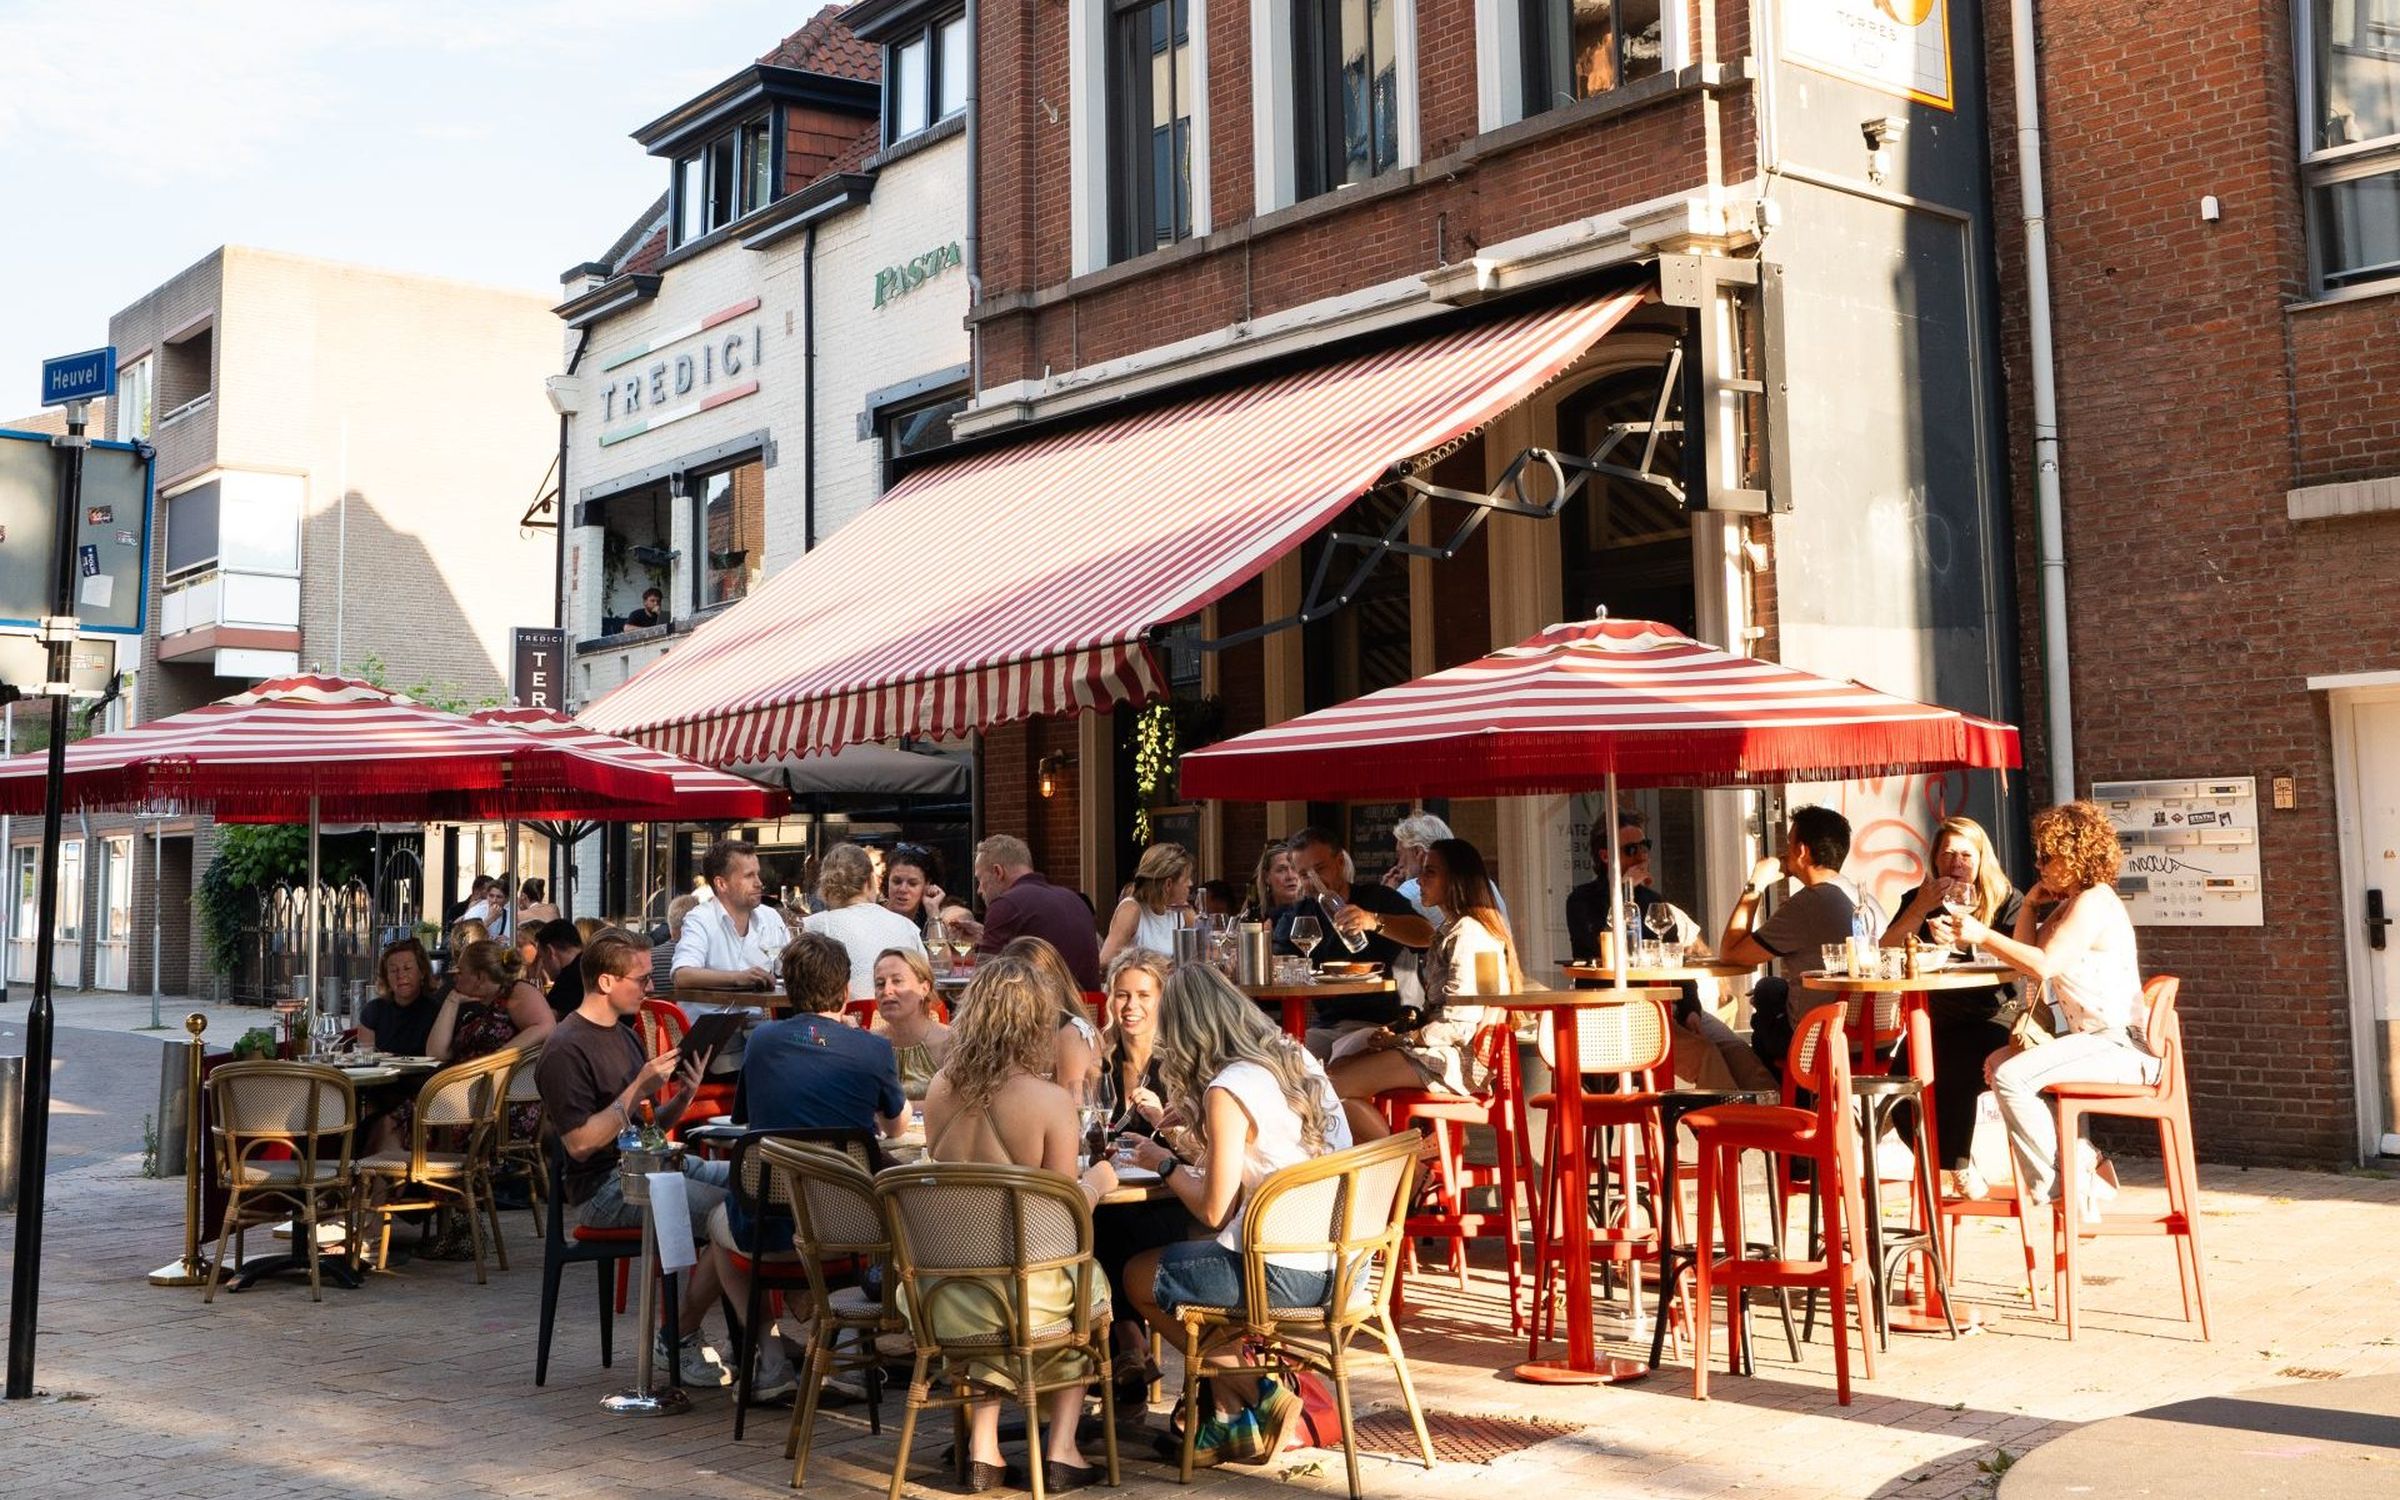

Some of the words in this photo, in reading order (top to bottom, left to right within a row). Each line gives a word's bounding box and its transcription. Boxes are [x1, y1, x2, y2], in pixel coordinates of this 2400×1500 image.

[872, 240, 961, 310] PASTA
[52, 362, 97, 390] Heuvel
[600, 323, 761, 422] TREDICI
[518, 634, 563, 643] TREDICI
